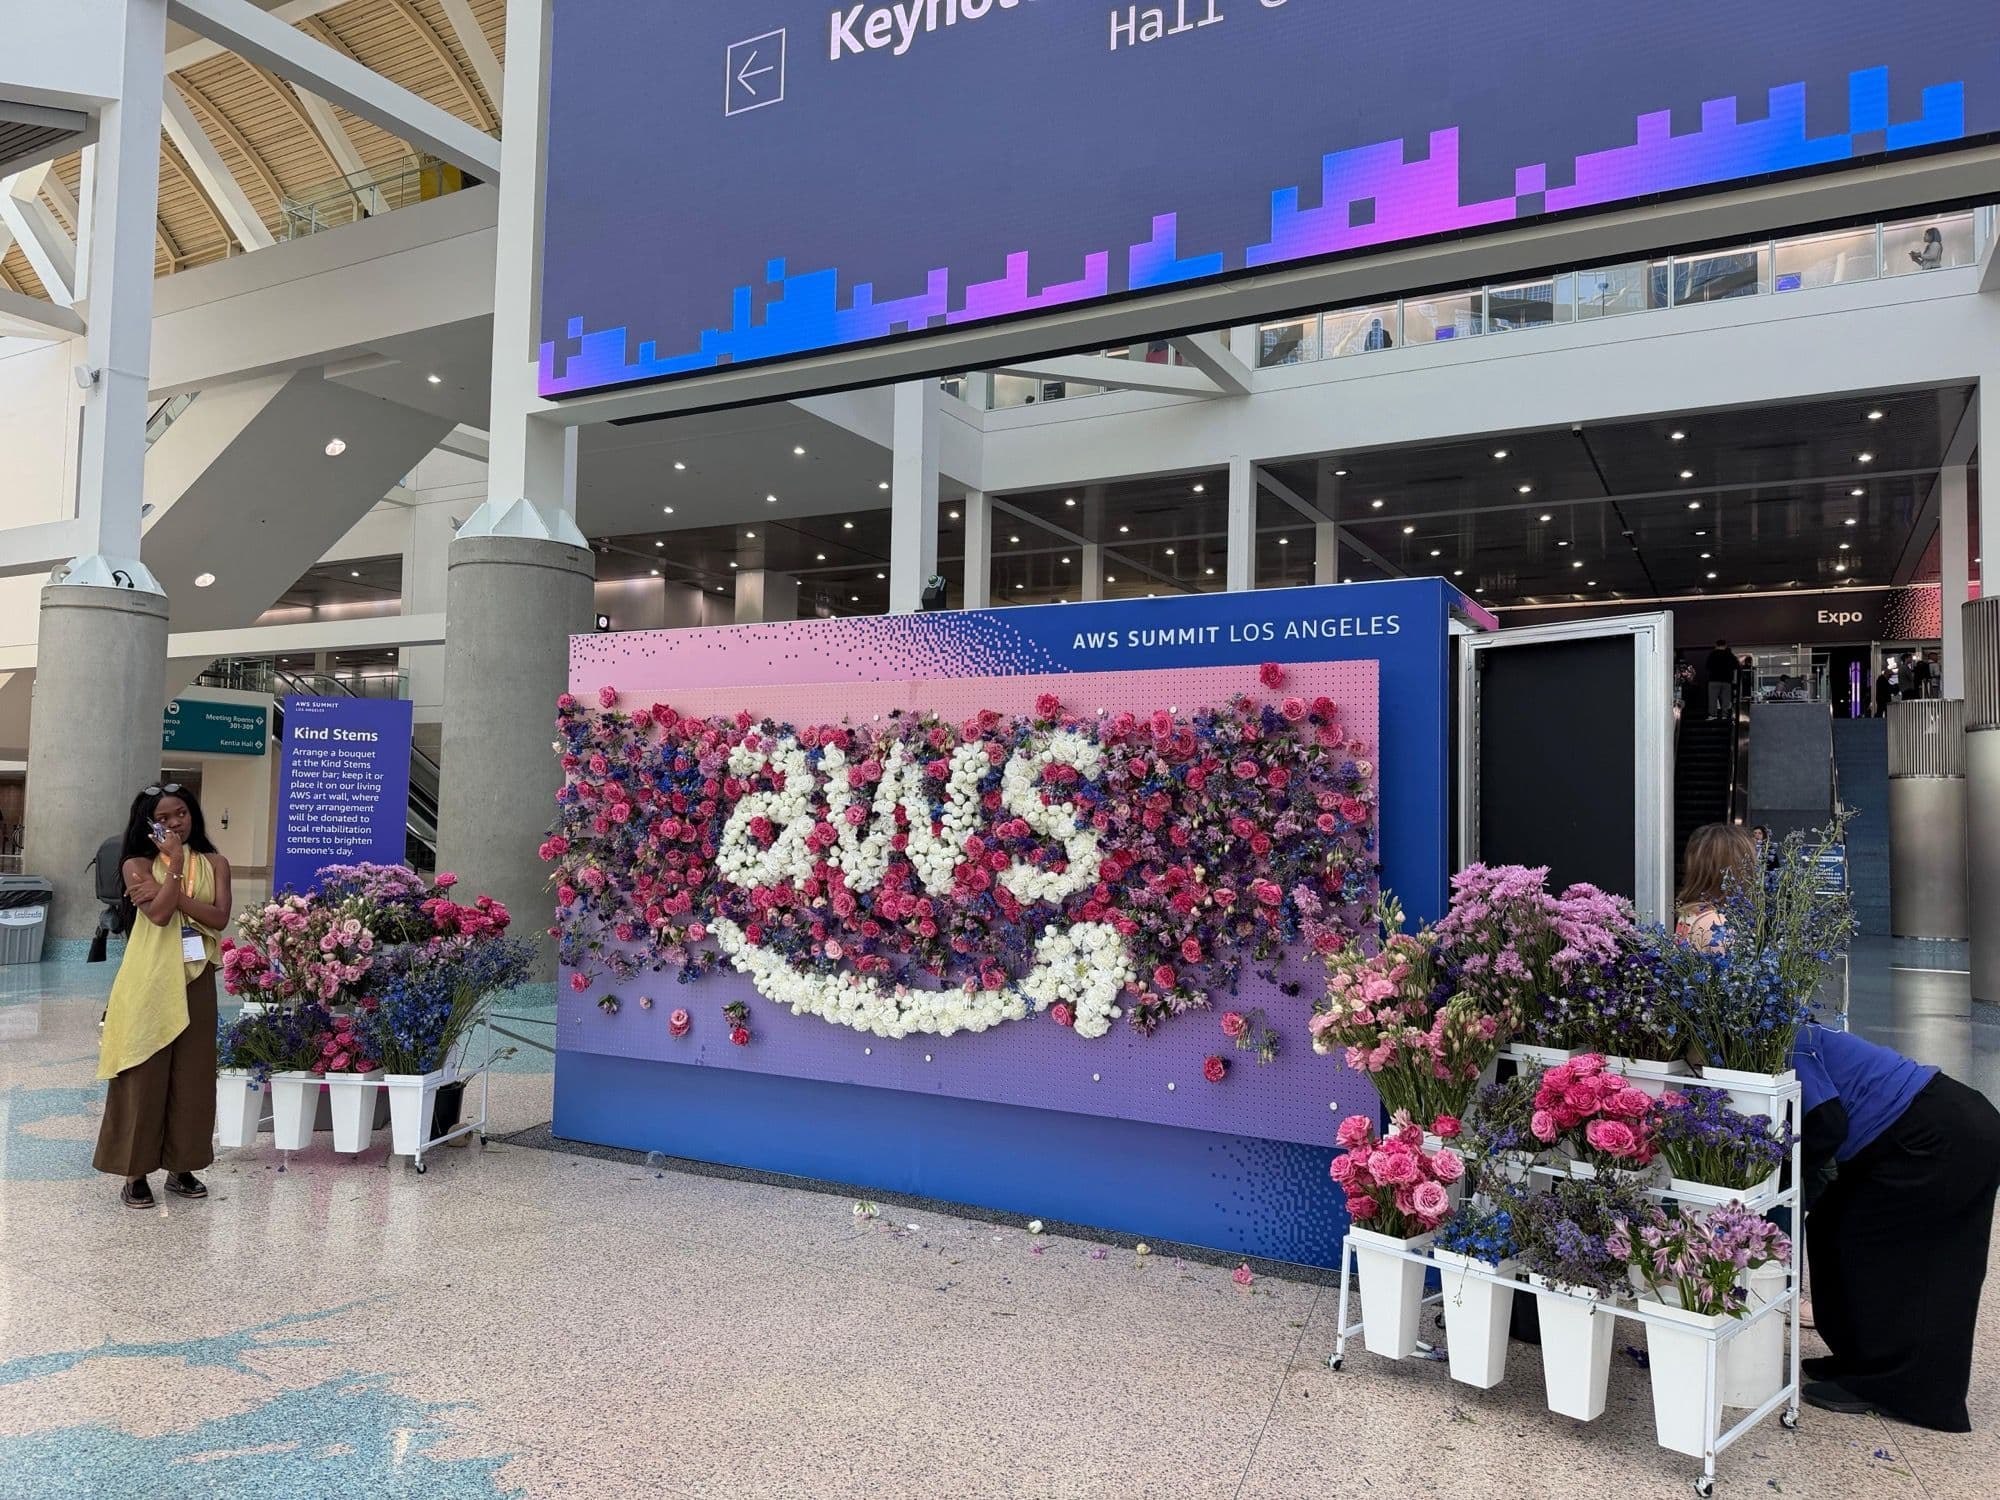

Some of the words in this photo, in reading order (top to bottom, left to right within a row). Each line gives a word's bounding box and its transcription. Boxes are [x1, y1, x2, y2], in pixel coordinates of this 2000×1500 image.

[830, 0, 1041, 60] Keyn
[1817, 610, 1863, 626] Expo
[1073, 632, 1119, 649] AWS
[1128, 626, 1220, 647] SUMMIT
[1230, 622, 1274, 643] LOS
[1284, 615, 1400, 639] ANGELES
[206, 714, 231, 722] Meeting
[294, 727, 328, 739] Kind
[333, 728, 378, 741] Stems
[292, 748, 328, 757] Arrange
[338, 749, 376, 759] bouquet
[321, 760, 341, 768] Kind
[344, 760, 371, 769] Stems
[292, 770, 320, 778] flower
[342, 771, 363, 780] keep
[291, 781, 314, 789] place
[317, 781, 323, 789] it
[357, 782, 381, 792] living
[329, 792, 349, 801] wall,
[352, 793, 379, 801] where
[289, 804, 314, 812] every
[317, 804, 374, 813] arrangement
[321, 814, 357, 823] donated
[717, 730, 1101, 903] aws
[288, 824, 309, 832] local
[312, 825, 371, 833] rehabilitation
[335, 836, 372, 845] brighten
[336, 847, 354, 856] day.
